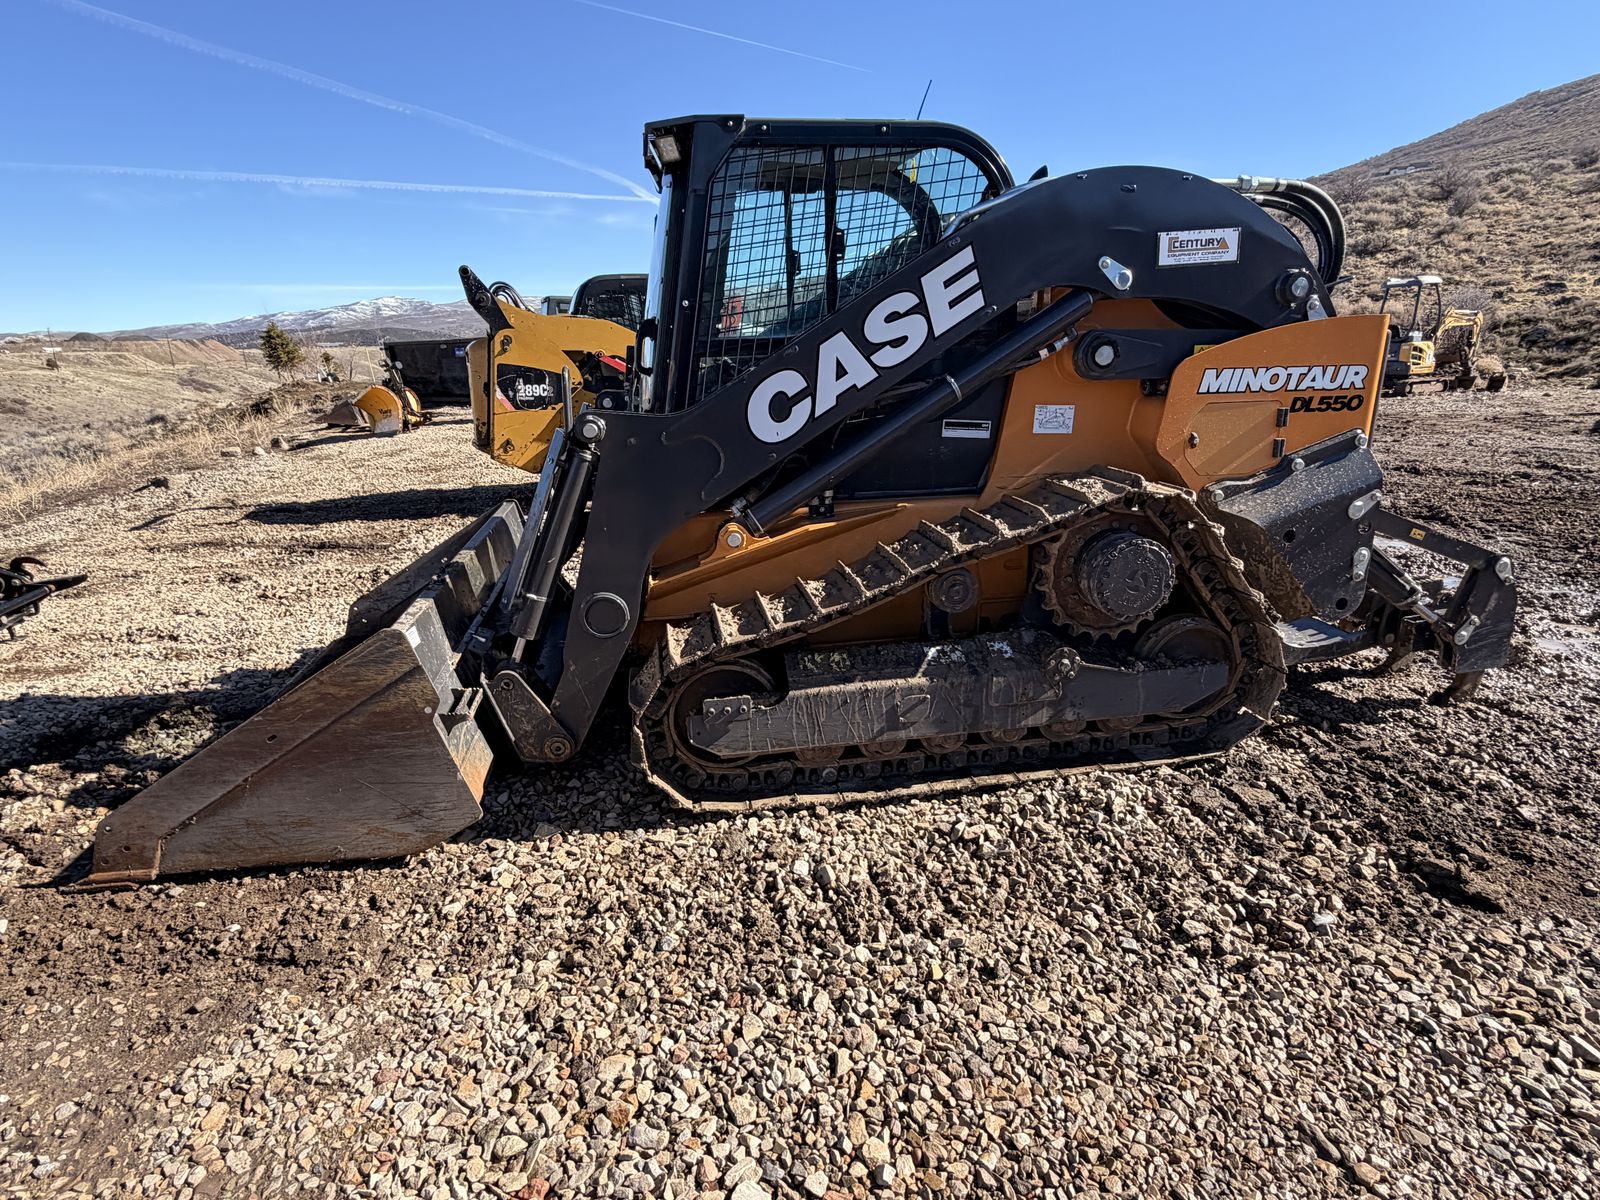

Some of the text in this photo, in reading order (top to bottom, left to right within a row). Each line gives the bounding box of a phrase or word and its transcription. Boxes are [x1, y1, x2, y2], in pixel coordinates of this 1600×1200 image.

[1172, 237, 1222, 249] CENTURY
[747, 244, 986, 443] CASE
[1198, 365, 1369, 394] MINOTAUR
[1290, 395, 1364, 413] DL550
